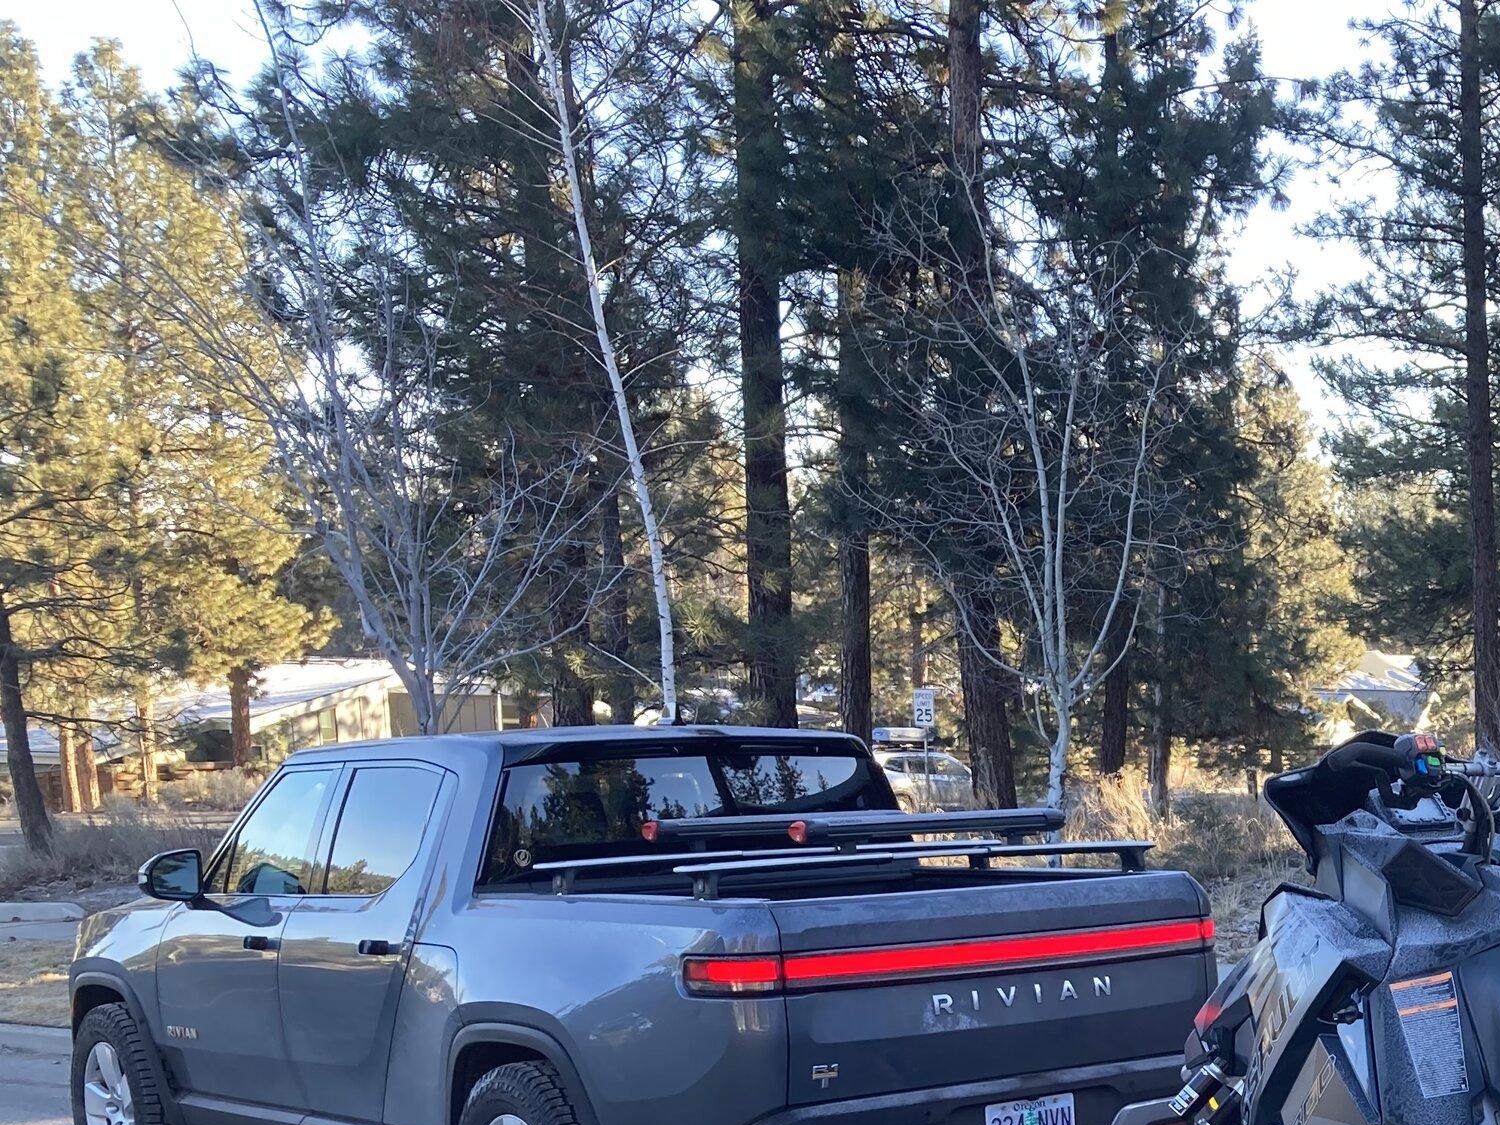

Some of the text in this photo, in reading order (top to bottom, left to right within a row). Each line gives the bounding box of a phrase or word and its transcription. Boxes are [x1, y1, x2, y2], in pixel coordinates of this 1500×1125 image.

[916, 708, 932, 722] 25
[932, 976, 1111, 1015] RIVIAN
[167, 1025, 198, 1039] RIVIAN
[1013, 1100, 1046, 1112] Oregon
